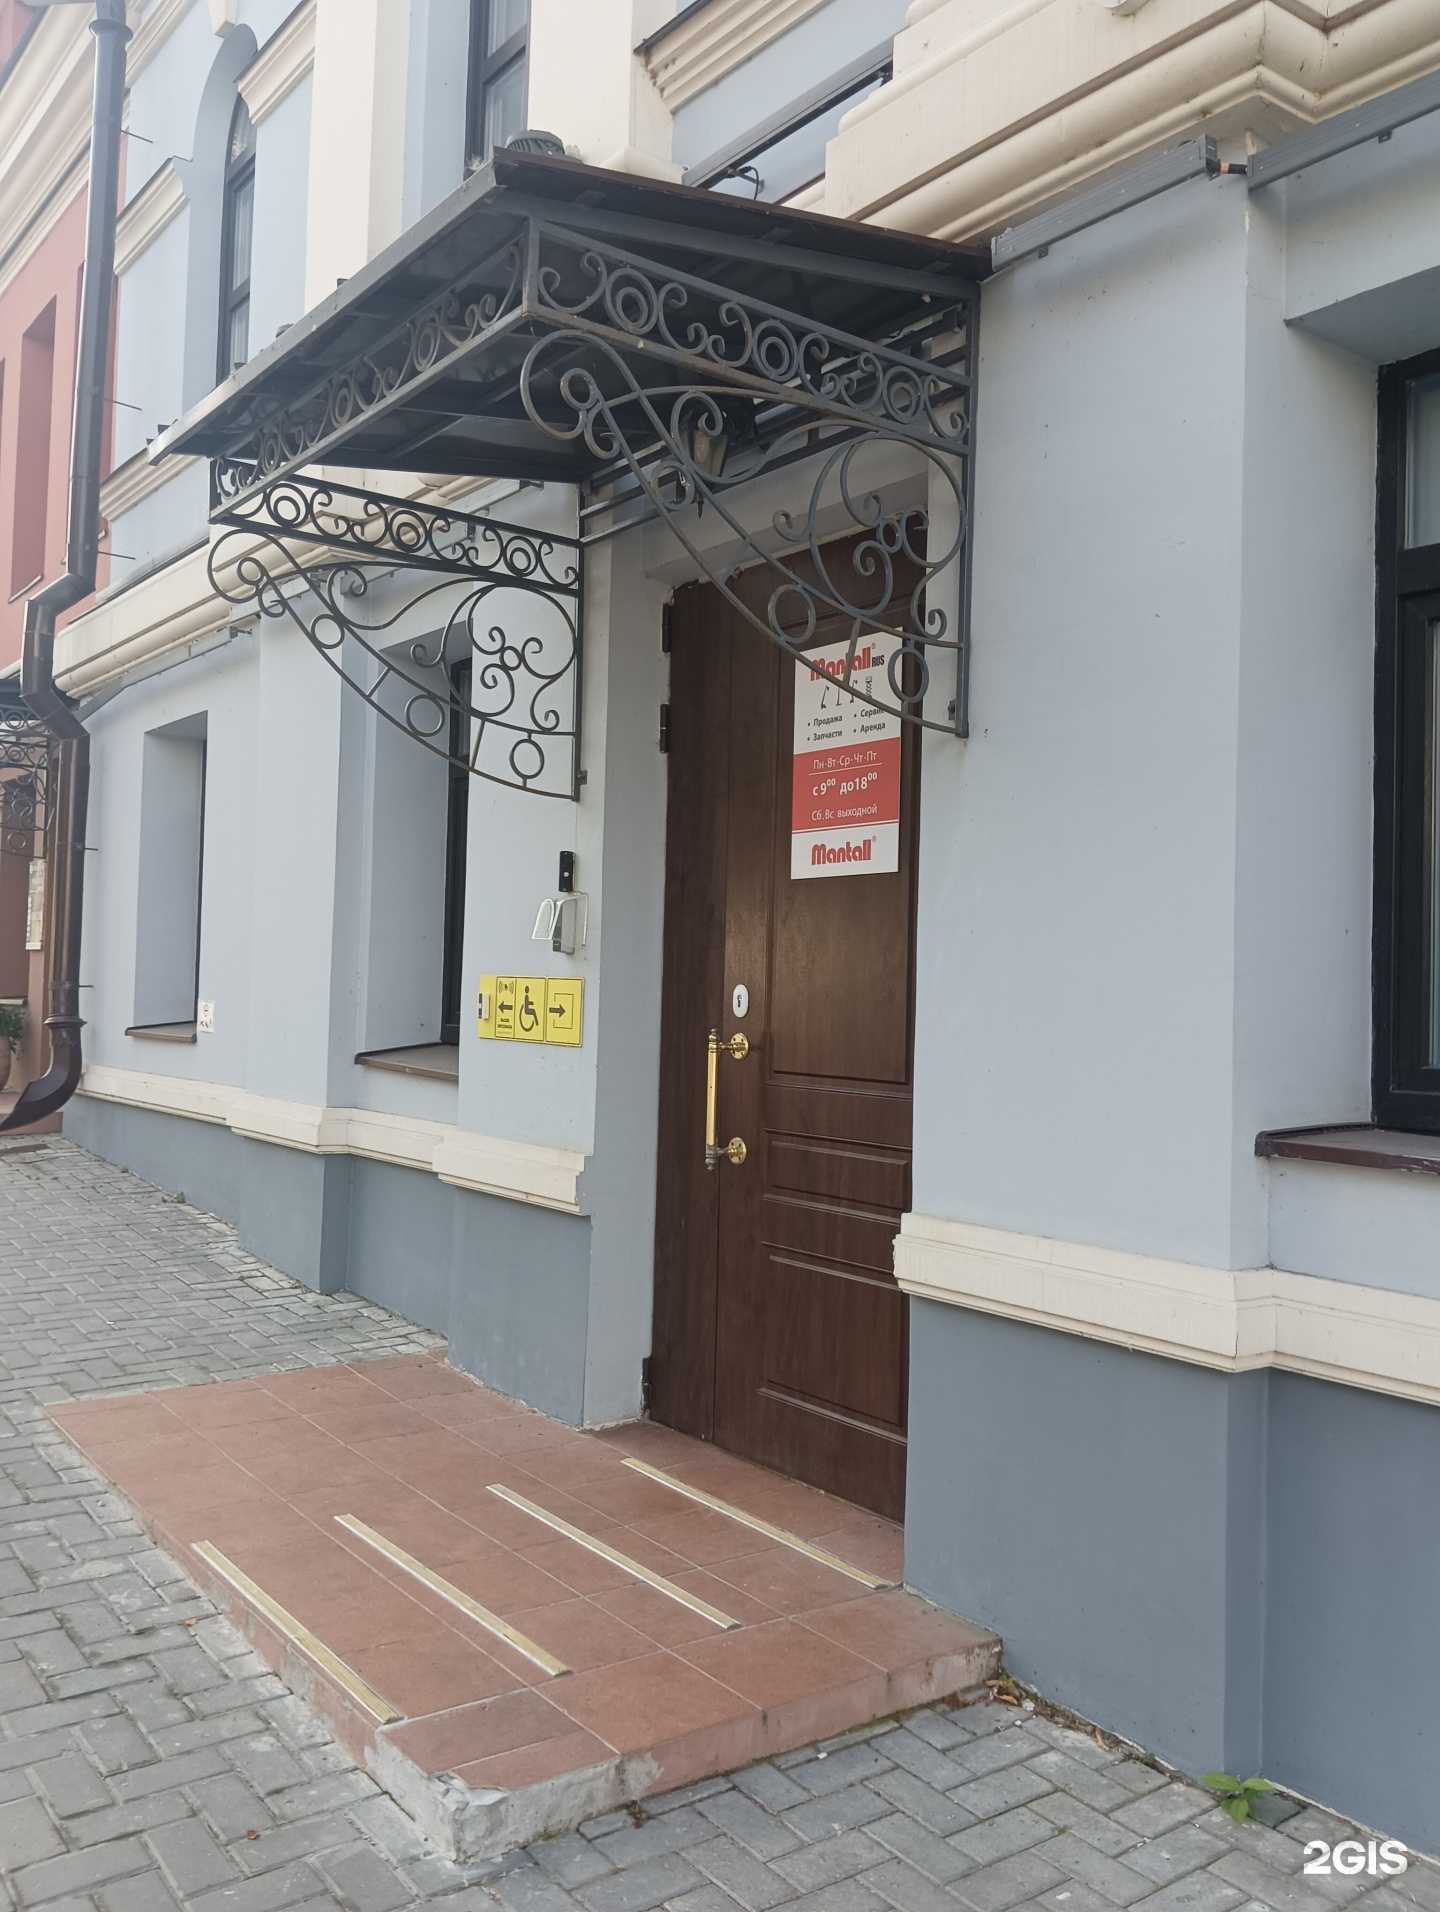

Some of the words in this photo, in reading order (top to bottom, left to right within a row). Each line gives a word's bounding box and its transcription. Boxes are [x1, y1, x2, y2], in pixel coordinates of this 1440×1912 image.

[813, 715, 843, 727] Продажа
[860, 722, 886, 734] Аренда
[813, 729, 843, 741] Запчасти
[837, 803, 878, 818] выходной
[811, 839, 872, 865] Mantall
